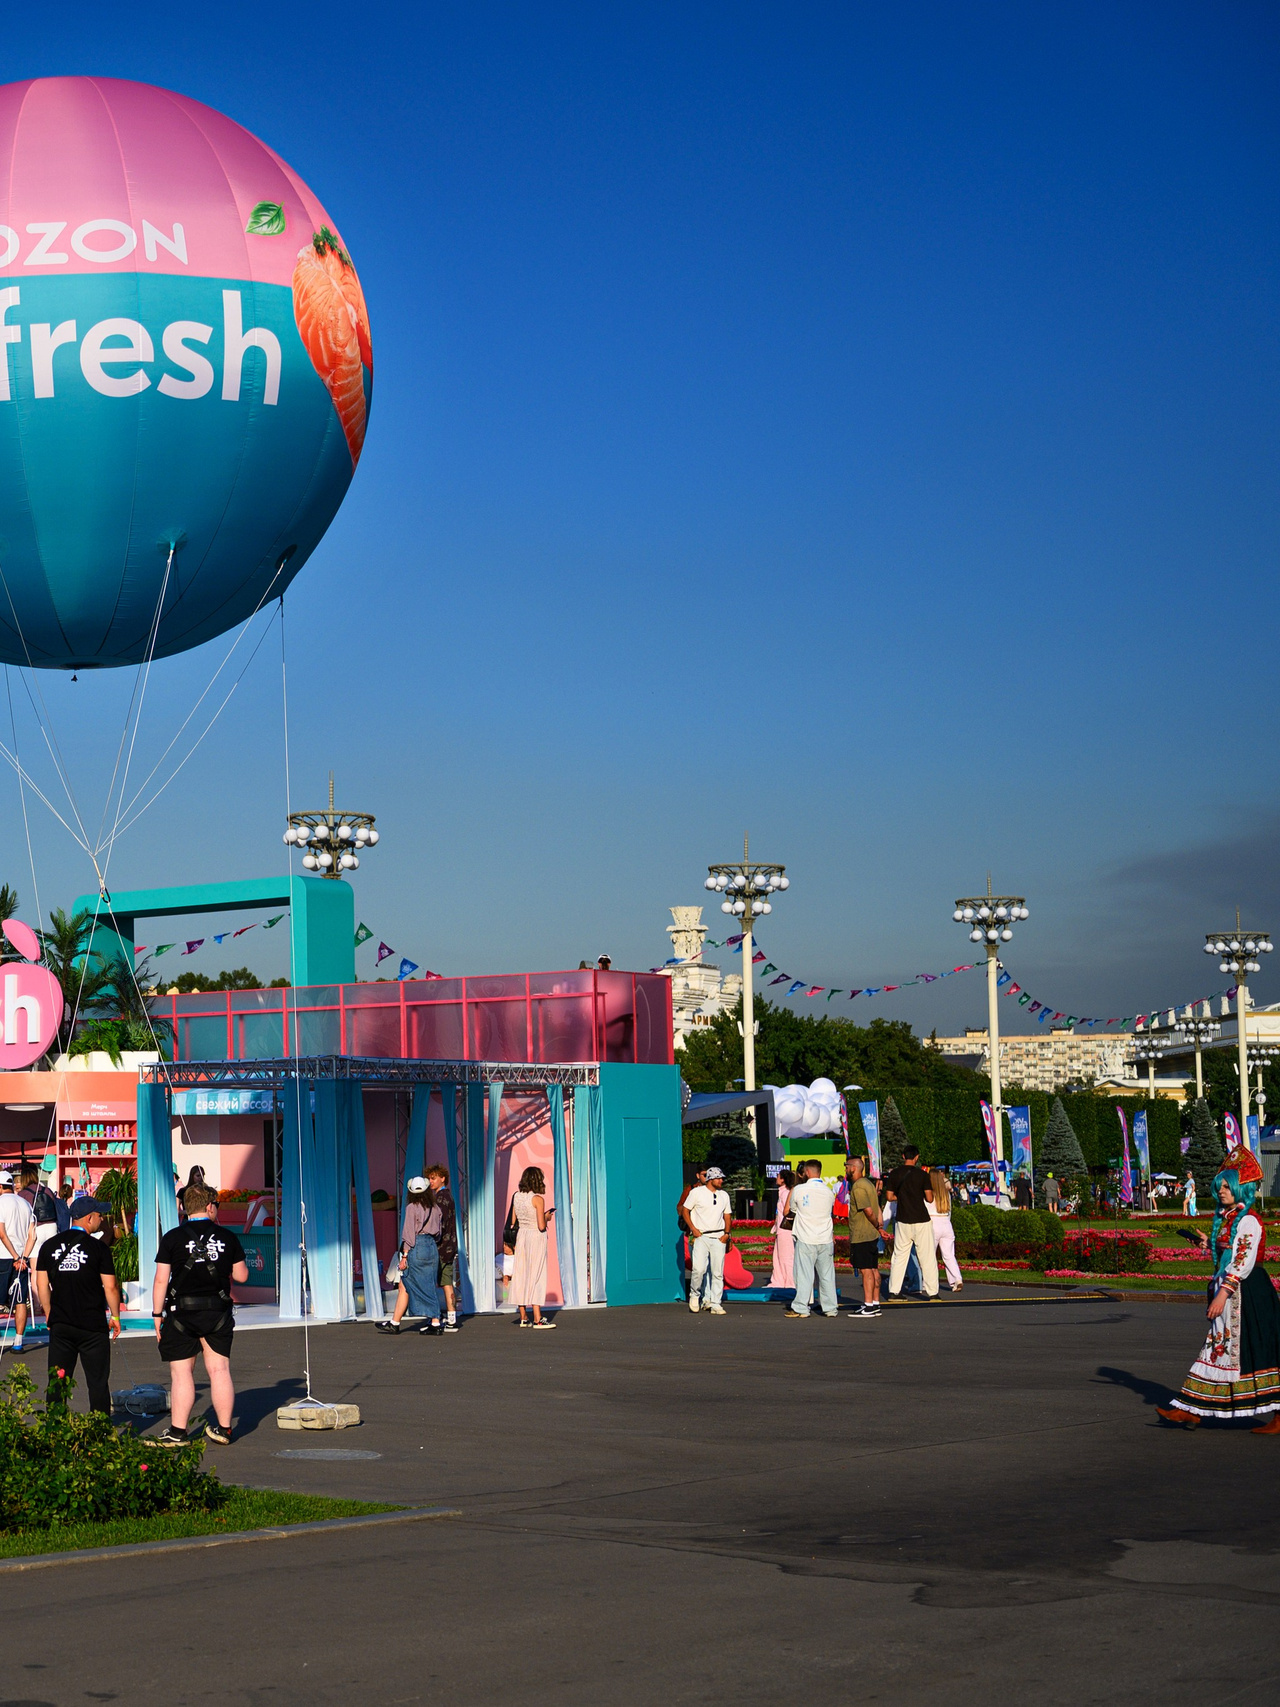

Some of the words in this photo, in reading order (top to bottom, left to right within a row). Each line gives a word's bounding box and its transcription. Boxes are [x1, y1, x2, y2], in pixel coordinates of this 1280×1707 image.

[196, 1097, 238, 1110] свежий
[242, 1100, 284, 1112] ассор
[185, 1240, 226, 1253] fst
